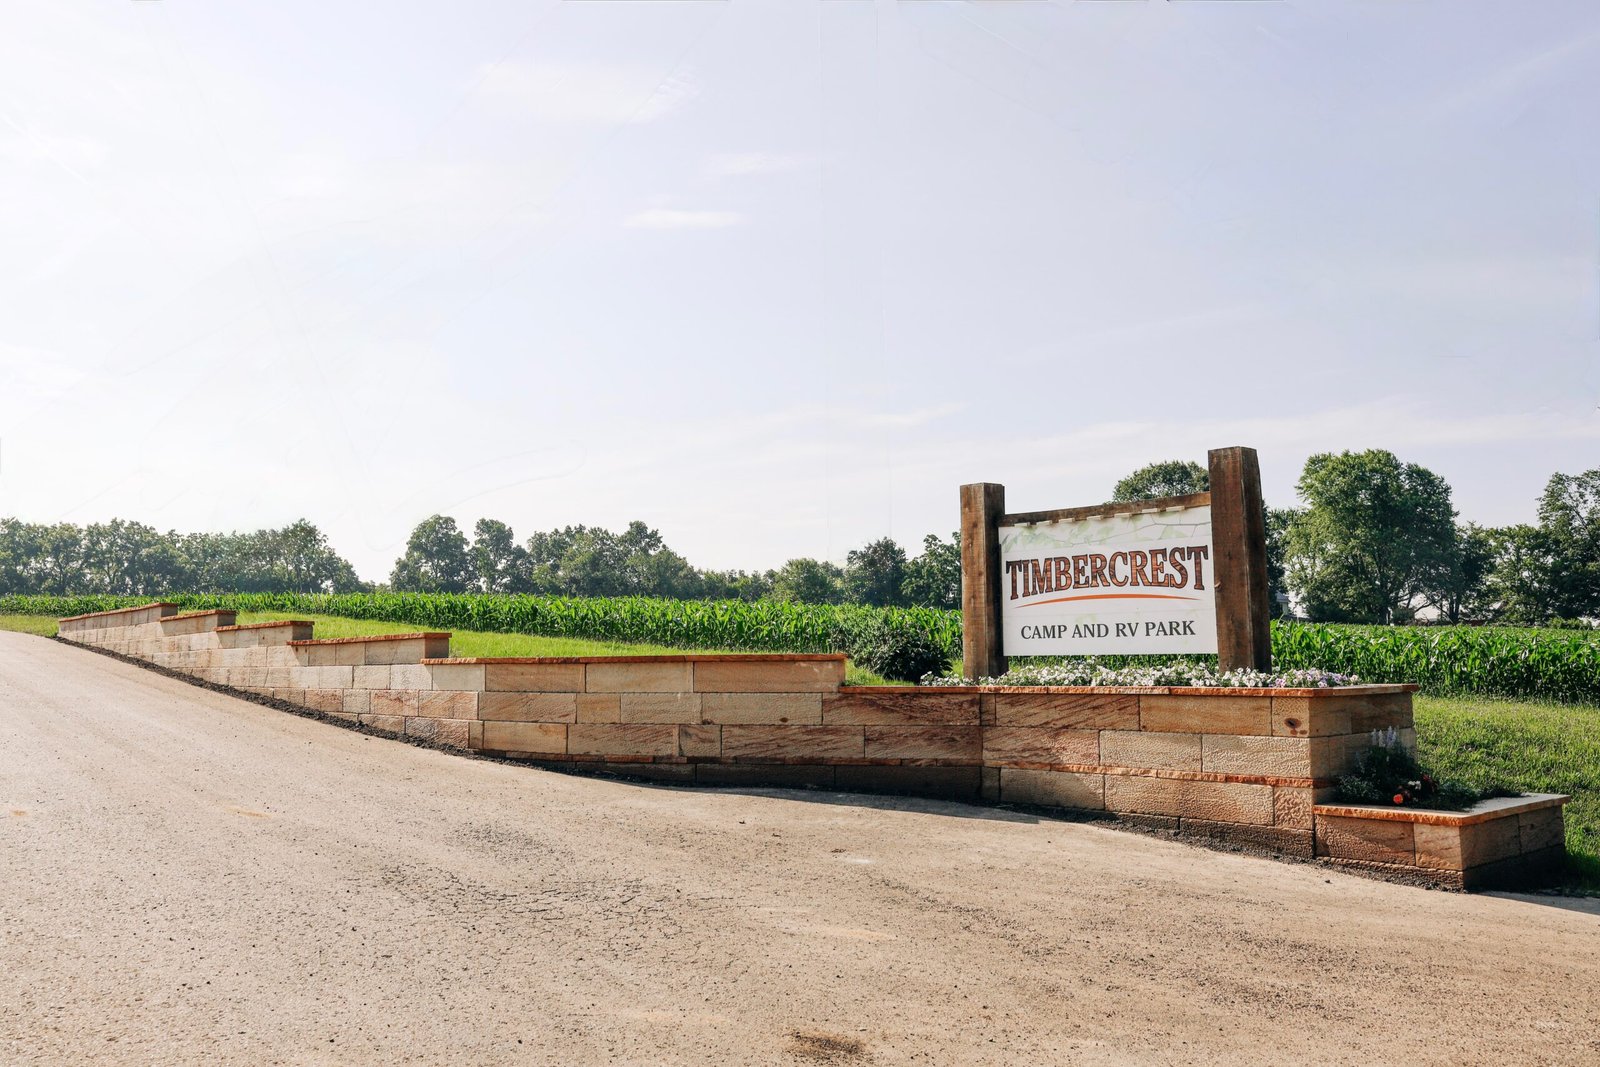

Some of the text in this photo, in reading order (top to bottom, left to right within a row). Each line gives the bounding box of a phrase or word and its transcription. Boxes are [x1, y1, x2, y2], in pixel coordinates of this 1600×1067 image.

[1006, 545, 1209, 600] TIMBERCREST
[1021, 620, 1196, 639] CAMP AND RV PARK
